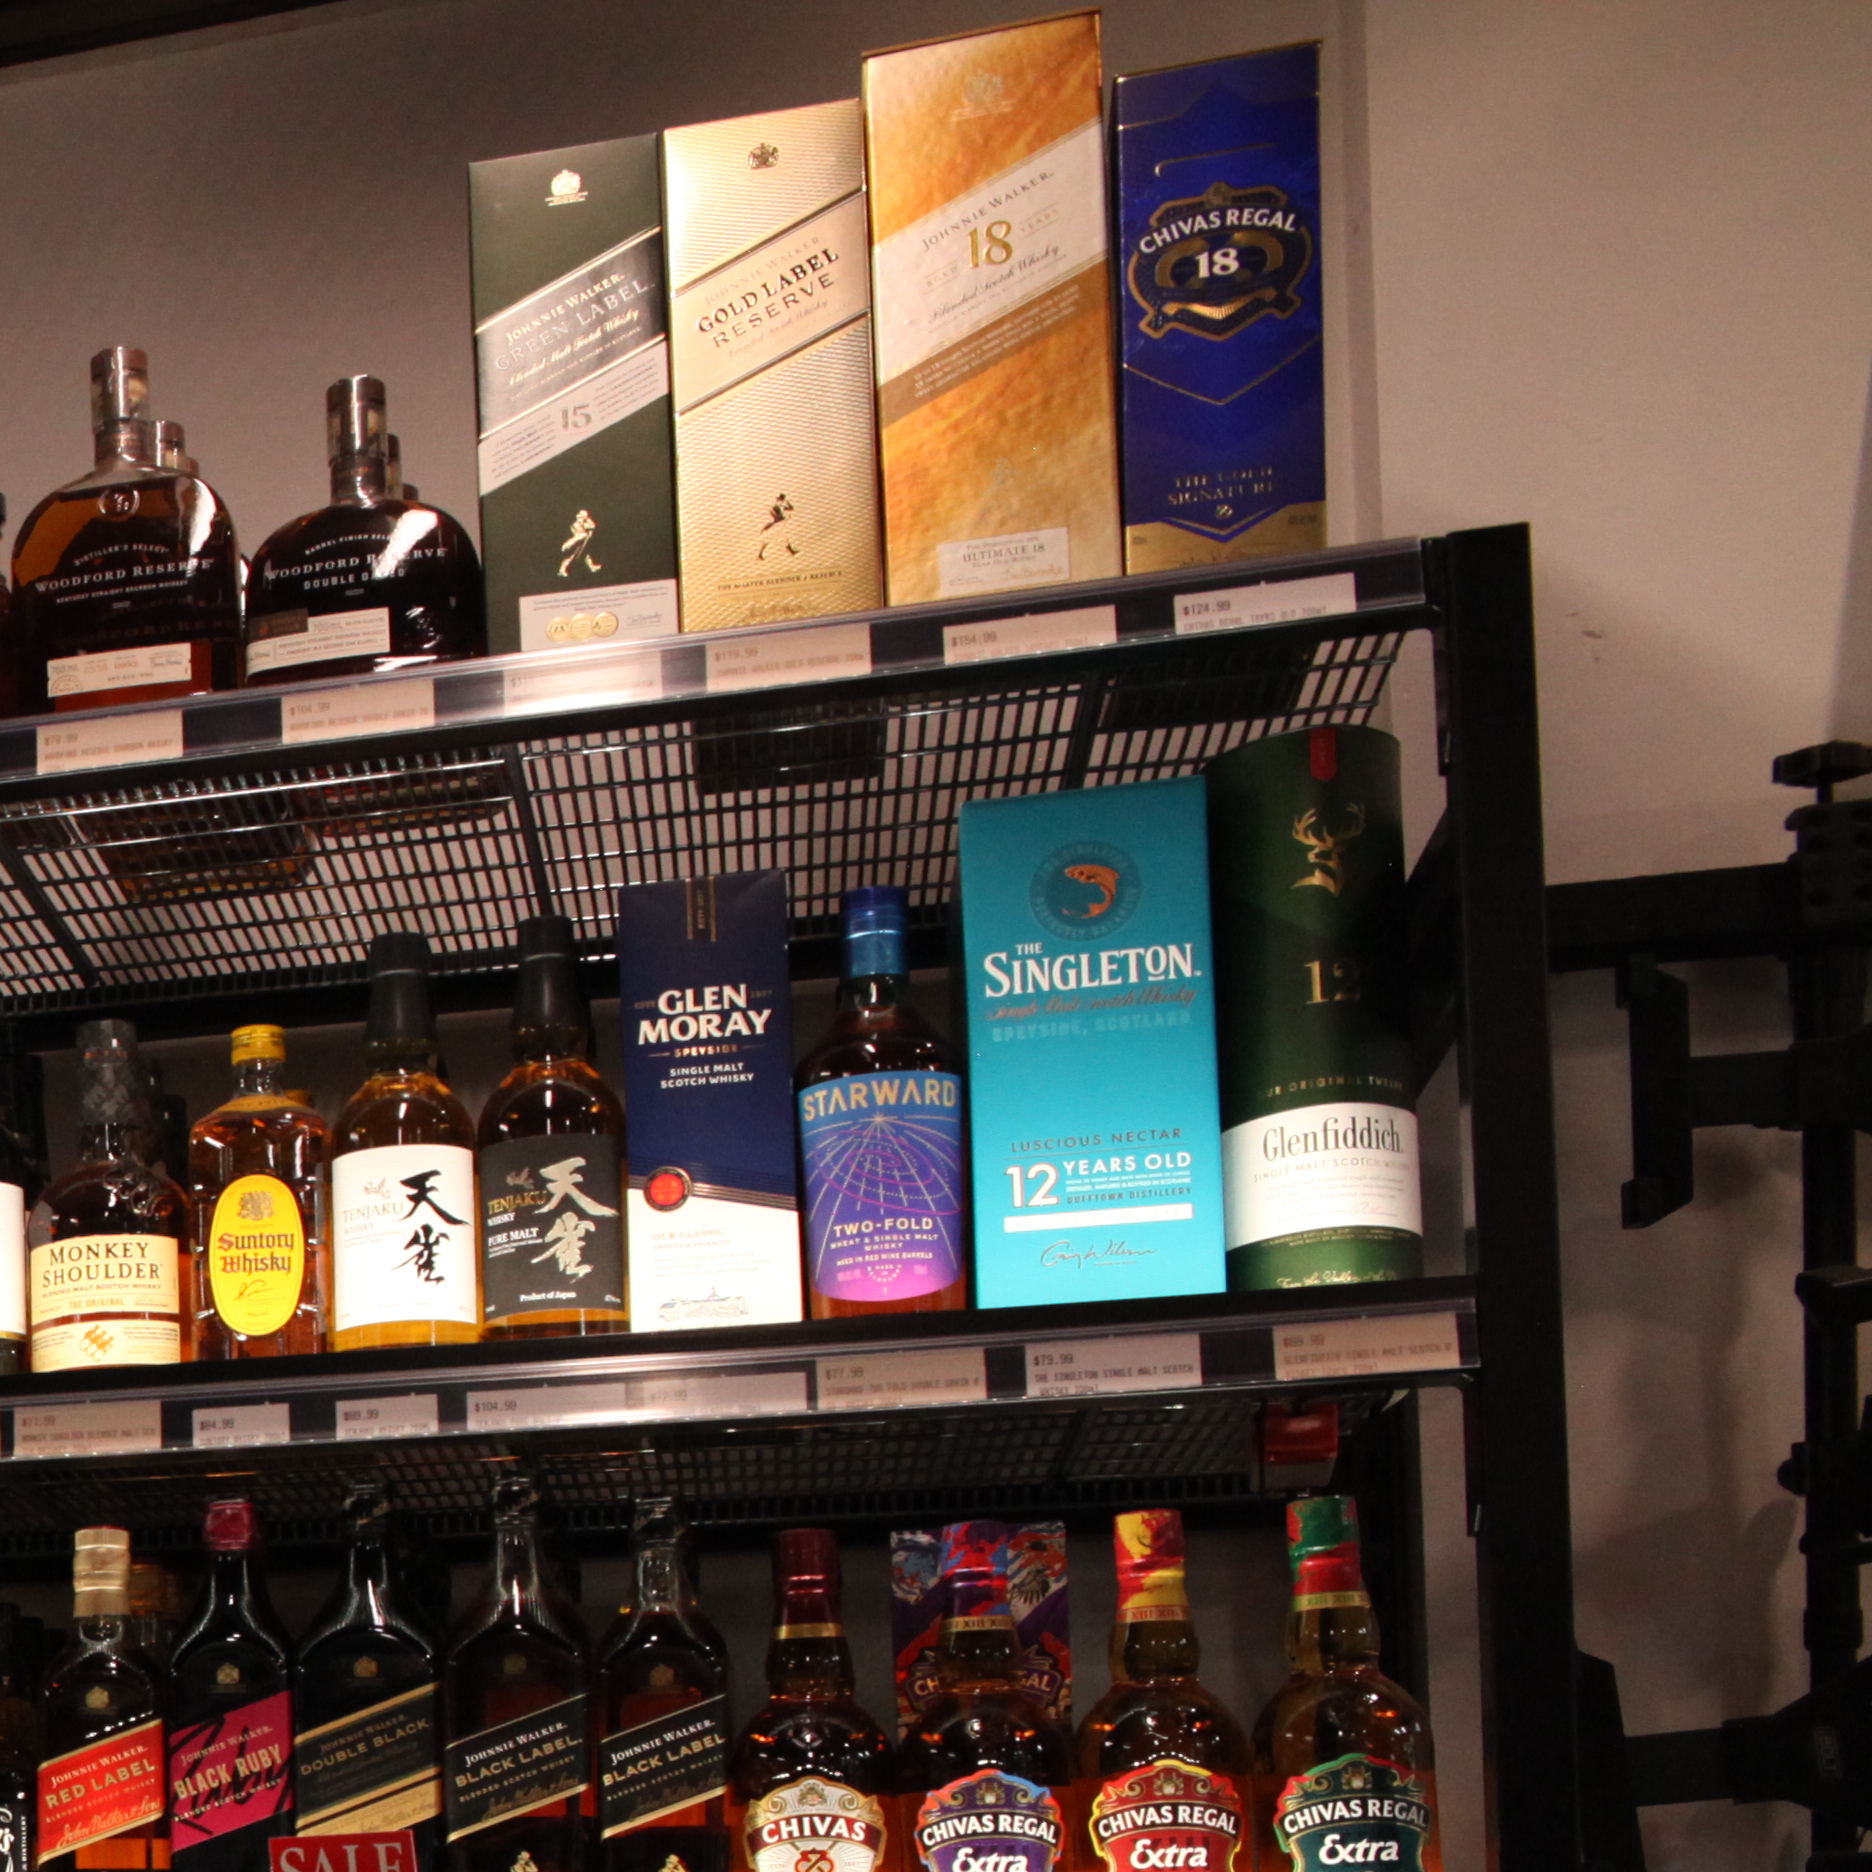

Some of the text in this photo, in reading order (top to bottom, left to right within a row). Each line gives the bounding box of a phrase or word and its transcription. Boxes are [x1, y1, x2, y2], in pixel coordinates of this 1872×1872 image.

[922, 201, 990, 252] JOHNNIE
[1139, 207, 1298, 253] CHIVAS REGAL
[968, 220, 1014, 269] 18
[1195, 247, 1240, 279] 18
[698, 248, 840, 333] GOLD LABEL
[506, 304, 565, 345] JOHNNIE
[713, 273, 835, 348] RESERVE
[35, 567, 126, 593] WOODFORD
[303, 573, 356, 590] DOUBLE
[1182, 600, 1231, 615] $124.99
[1015, 941, 1043, 956] THE
[1304, 959, 1362, 1005] 12
[658, 983, 747, 1016] GLEN
[637, 1008, 773, 1045] MORAY
[803, 1079, 957, 1122] STARWARD
[1110, 1127, 1182, 1143] NECTAR
[1262, 1116, 1401, 1163] Glenfiddich
[1063, 1150, 1192, 1175] YEARS OLD
[1005, 1163, 1059, 1209] 12
[217, 1230, 295, 1252] Suntory
[833, 1218, 934, 1237] TWO-FOLD
[49, 1241, 149, 1264] MONKEY
[220, 1252, 292, 1275] Whisky
[42, 1262, 161, 1288] SHOULDER
[299, 1740, 369, 1776] DOUBLE
[464, 1738, 513, 1767] JOHNNIE
[45, 1759, 156, 1811] RED LABEL
[173, 1743, 284, 1801] BLACK RUBY
[455, 1755, 515, 1787] BLACK
[602, 1755, 664, 1786] BLACK
[762, 1816, 867, 1845] CHIVAS
[921, 1813, 1057, 1846] CHIVAS REGAL
[1097, 1807, 1239, 1839] CHIVAS REGAL
[1283, 1799, 1427, 1833] CHIVAS REGAL
[1128, 1838, 1208, 1871] Extra
[1318, 1833, 1399, 1865] Extra
